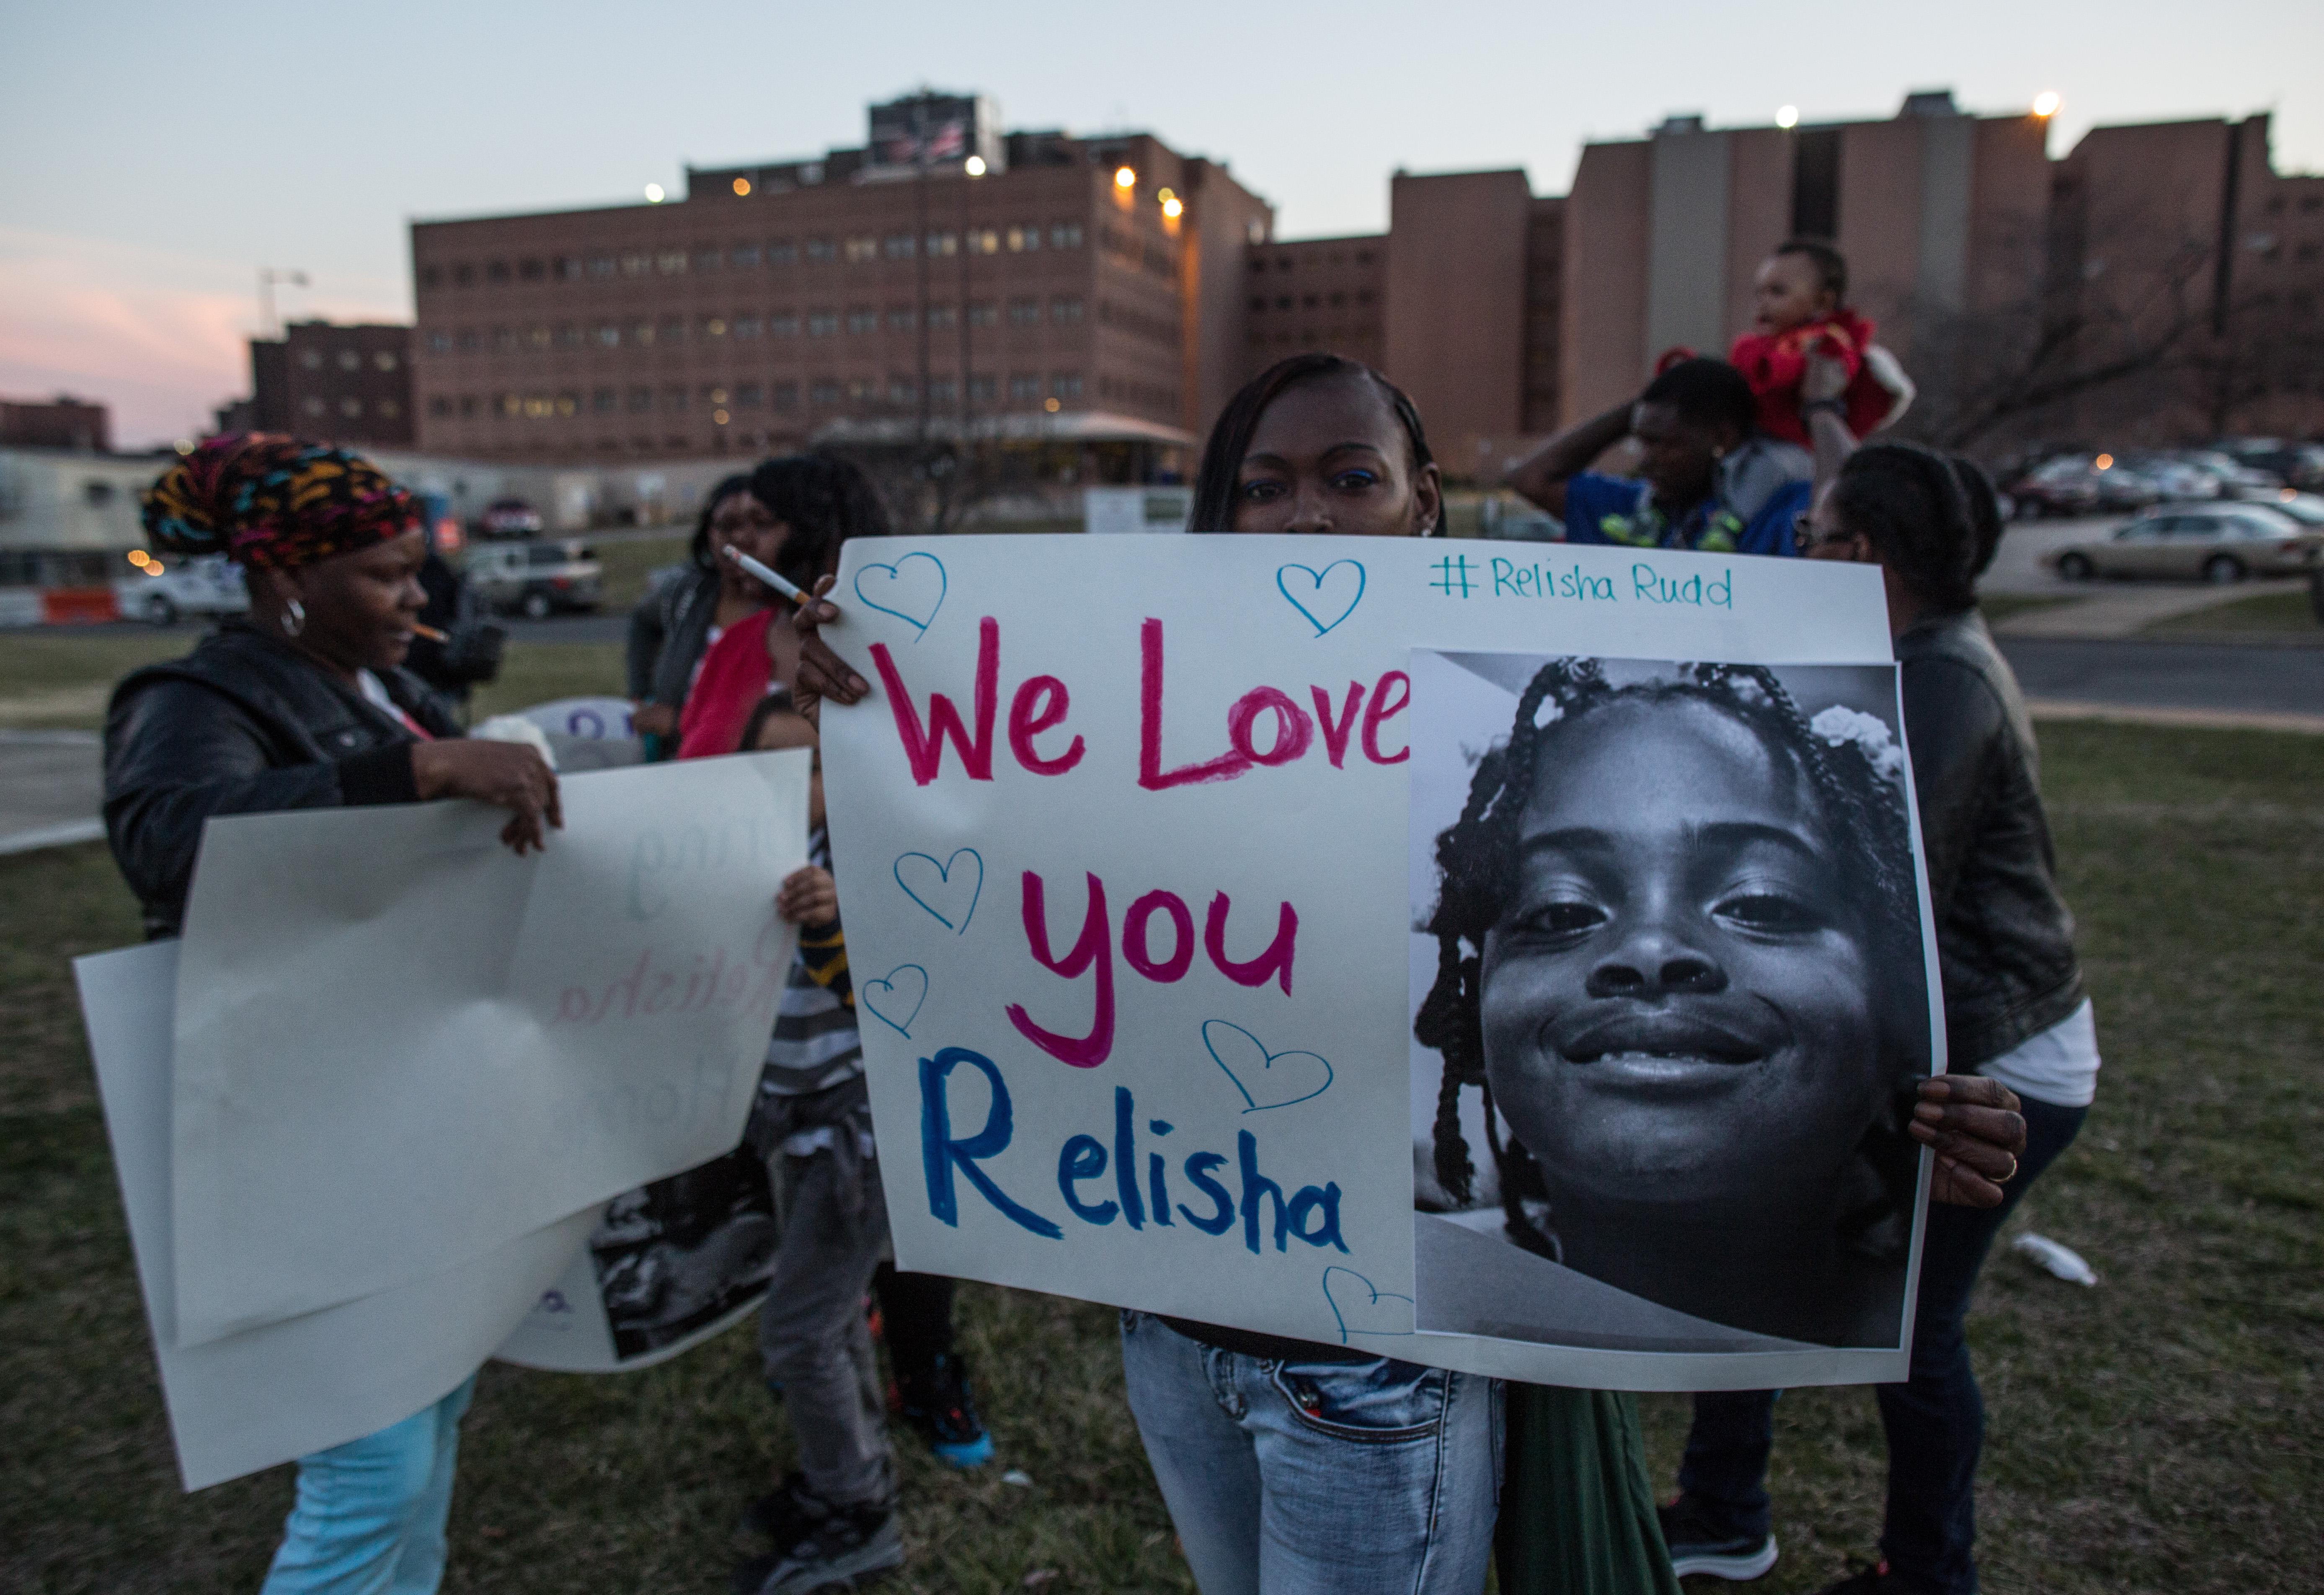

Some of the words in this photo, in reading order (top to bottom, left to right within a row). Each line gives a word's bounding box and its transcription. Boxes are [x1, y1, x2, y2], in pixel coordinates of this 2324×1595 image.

[868, 616, 1086, 787] We
[1137, 617, 1410, 791] Love
[1005, 870, 1299, 1069] you
[917, 1046, 1351, 1255] Relisha
